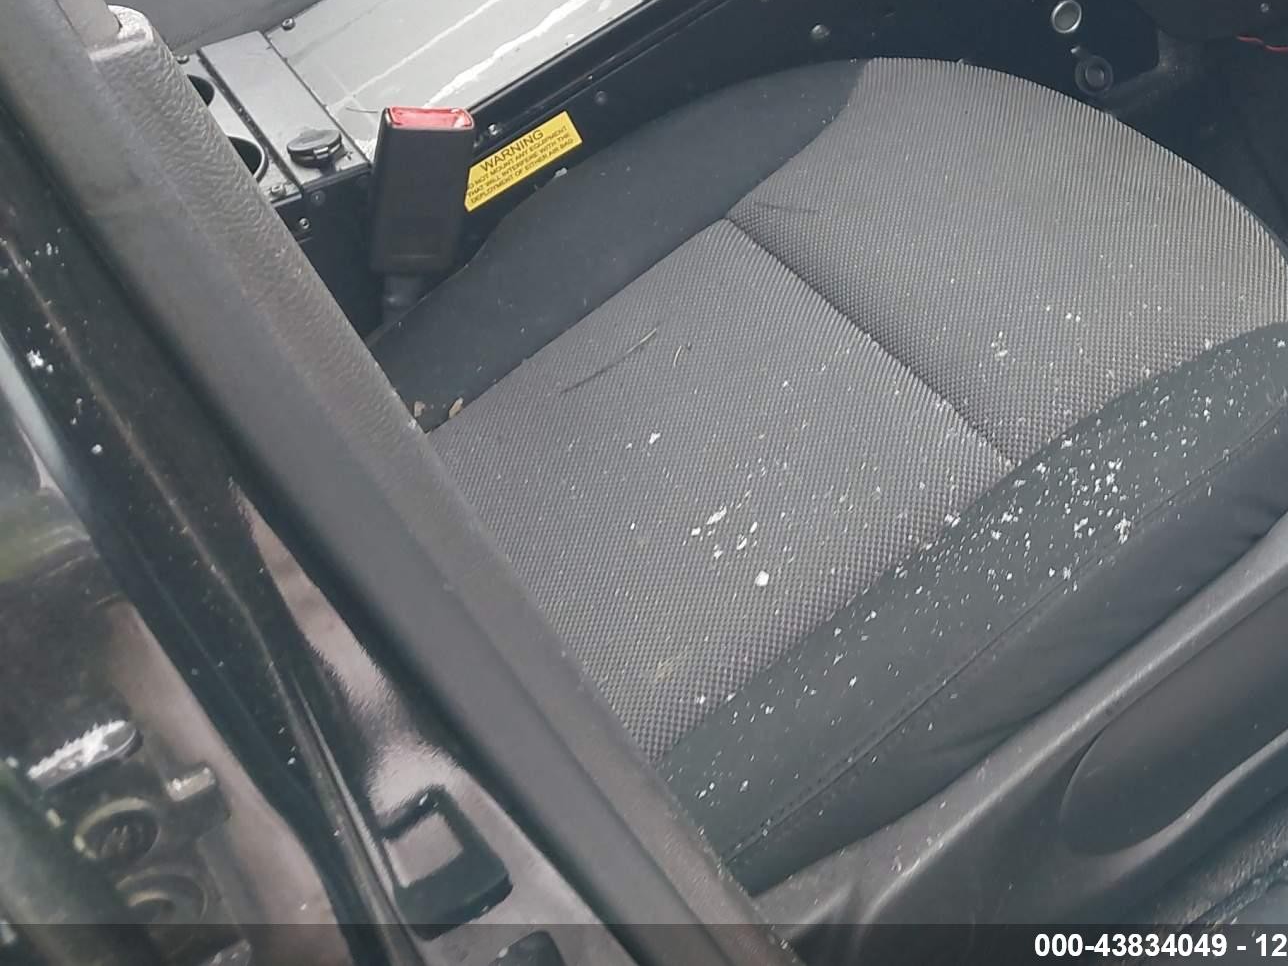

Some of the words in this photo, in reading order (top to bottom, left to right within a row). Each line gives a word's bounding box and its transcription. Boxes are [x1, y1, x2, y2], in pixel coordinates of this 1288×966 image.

[467, 185, 484, 197] THAT
[484, 174, 500, 186] WILL
[500, 151, 538, 176] INTERFERE
[538, 139, 558, 153] WITH
[556, 131, 571, 142] THE
[470, 175, 515, 203] DEPLOYMENT
[513, 168, 524, 177] OF
[524, 153, 548, 170] EITHER
[547, 146, 559, 156] AIR
[558, 137, 574, 149] BAG
[474, 173, 489, 184] NOT
[489, 158, 514, 175] MOUNT
[513, 149, 529, 161] ANY
[528, 125, 567, 151] EQUIPMENT
[480, 129, 544, 172] WARNING
